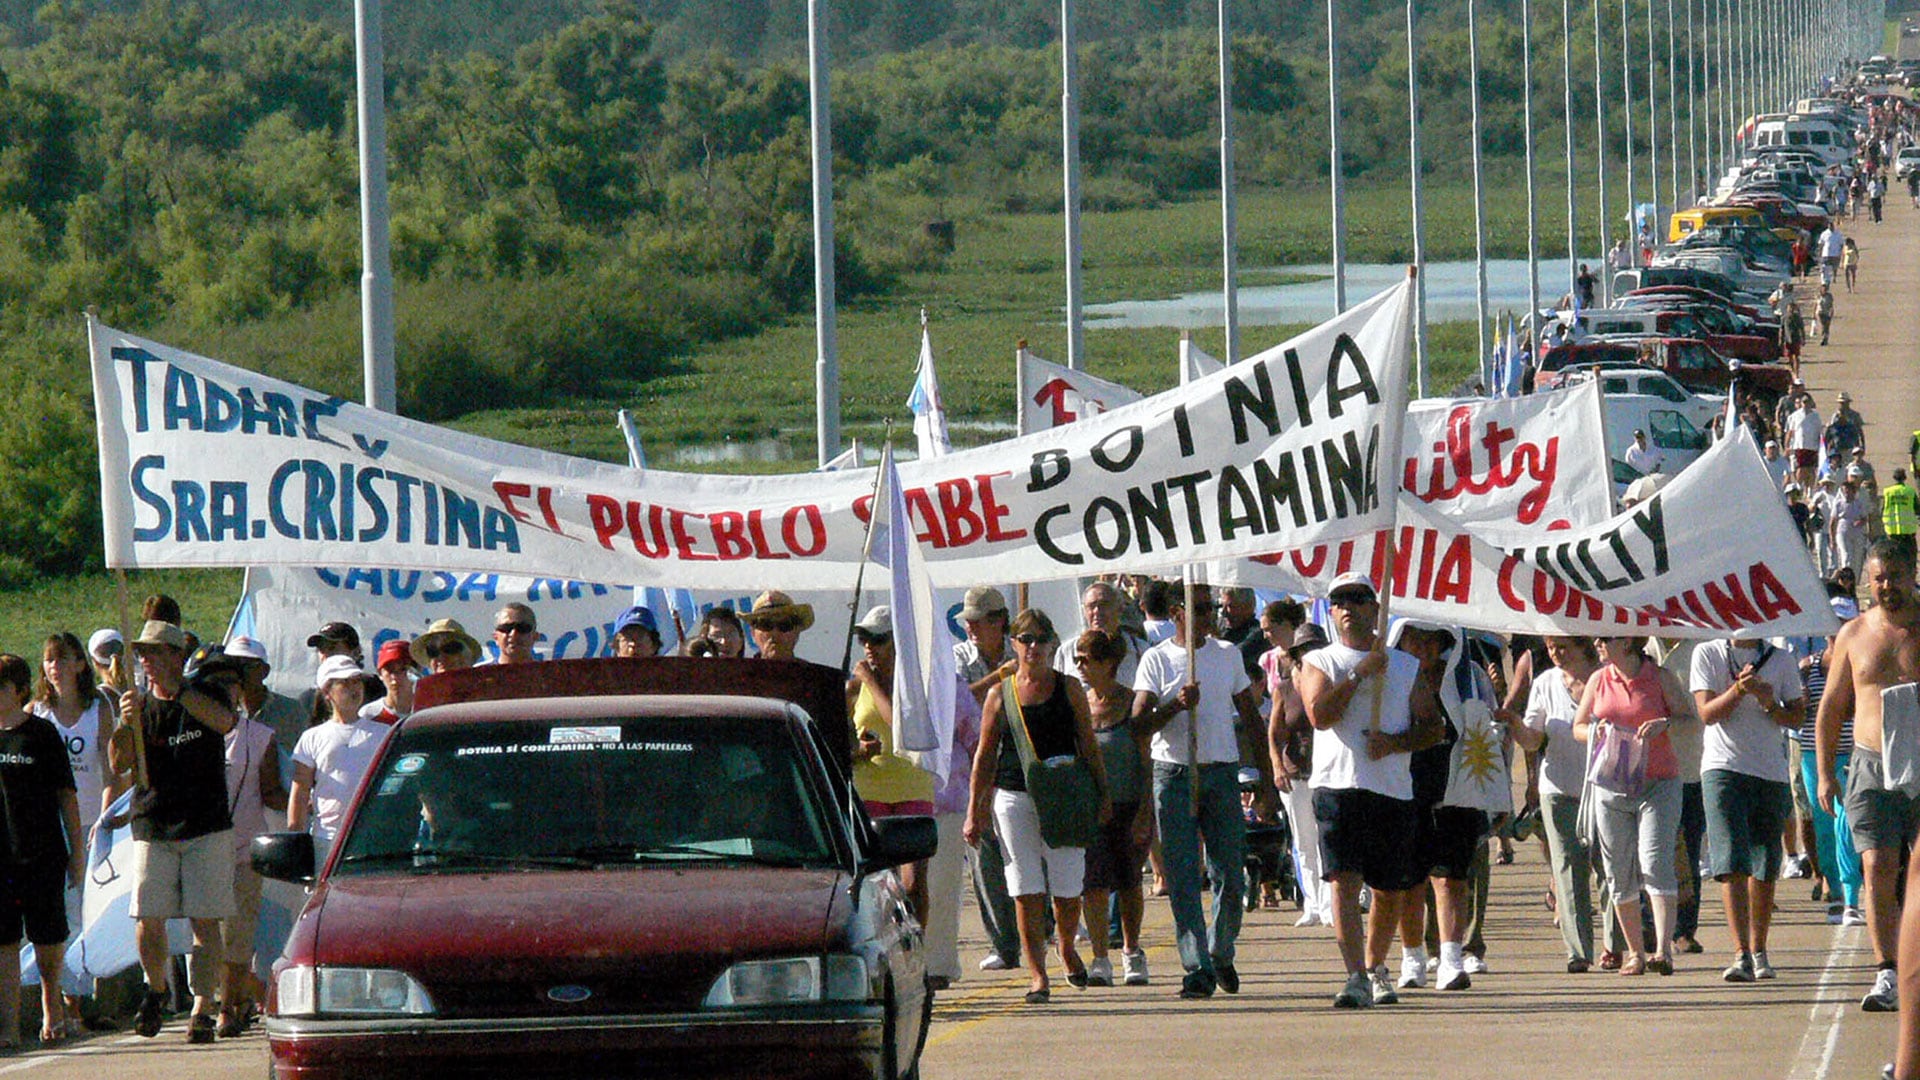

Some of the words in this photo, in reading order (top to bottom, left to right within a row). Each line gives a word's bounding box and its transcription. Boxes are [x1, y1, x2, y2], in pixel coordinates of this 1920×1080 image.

[268, 458, 521, 555] CRISTINA
[586, 494, 827, 560] PUEBLO
[1034, 423, 1380, 565] CONTAMINA
[1496, 560, 1803, 632] CONAMINA
[457, 745, 503, 756] BOTNIA
[521, 742, 595, 753] CONTAMINA
[602, 742, 617, 751] NO
[618, 743, 625, 751] A
[626, 742, 643, 751] LAS
[645, 742, 694, 752] PAPELERAS
